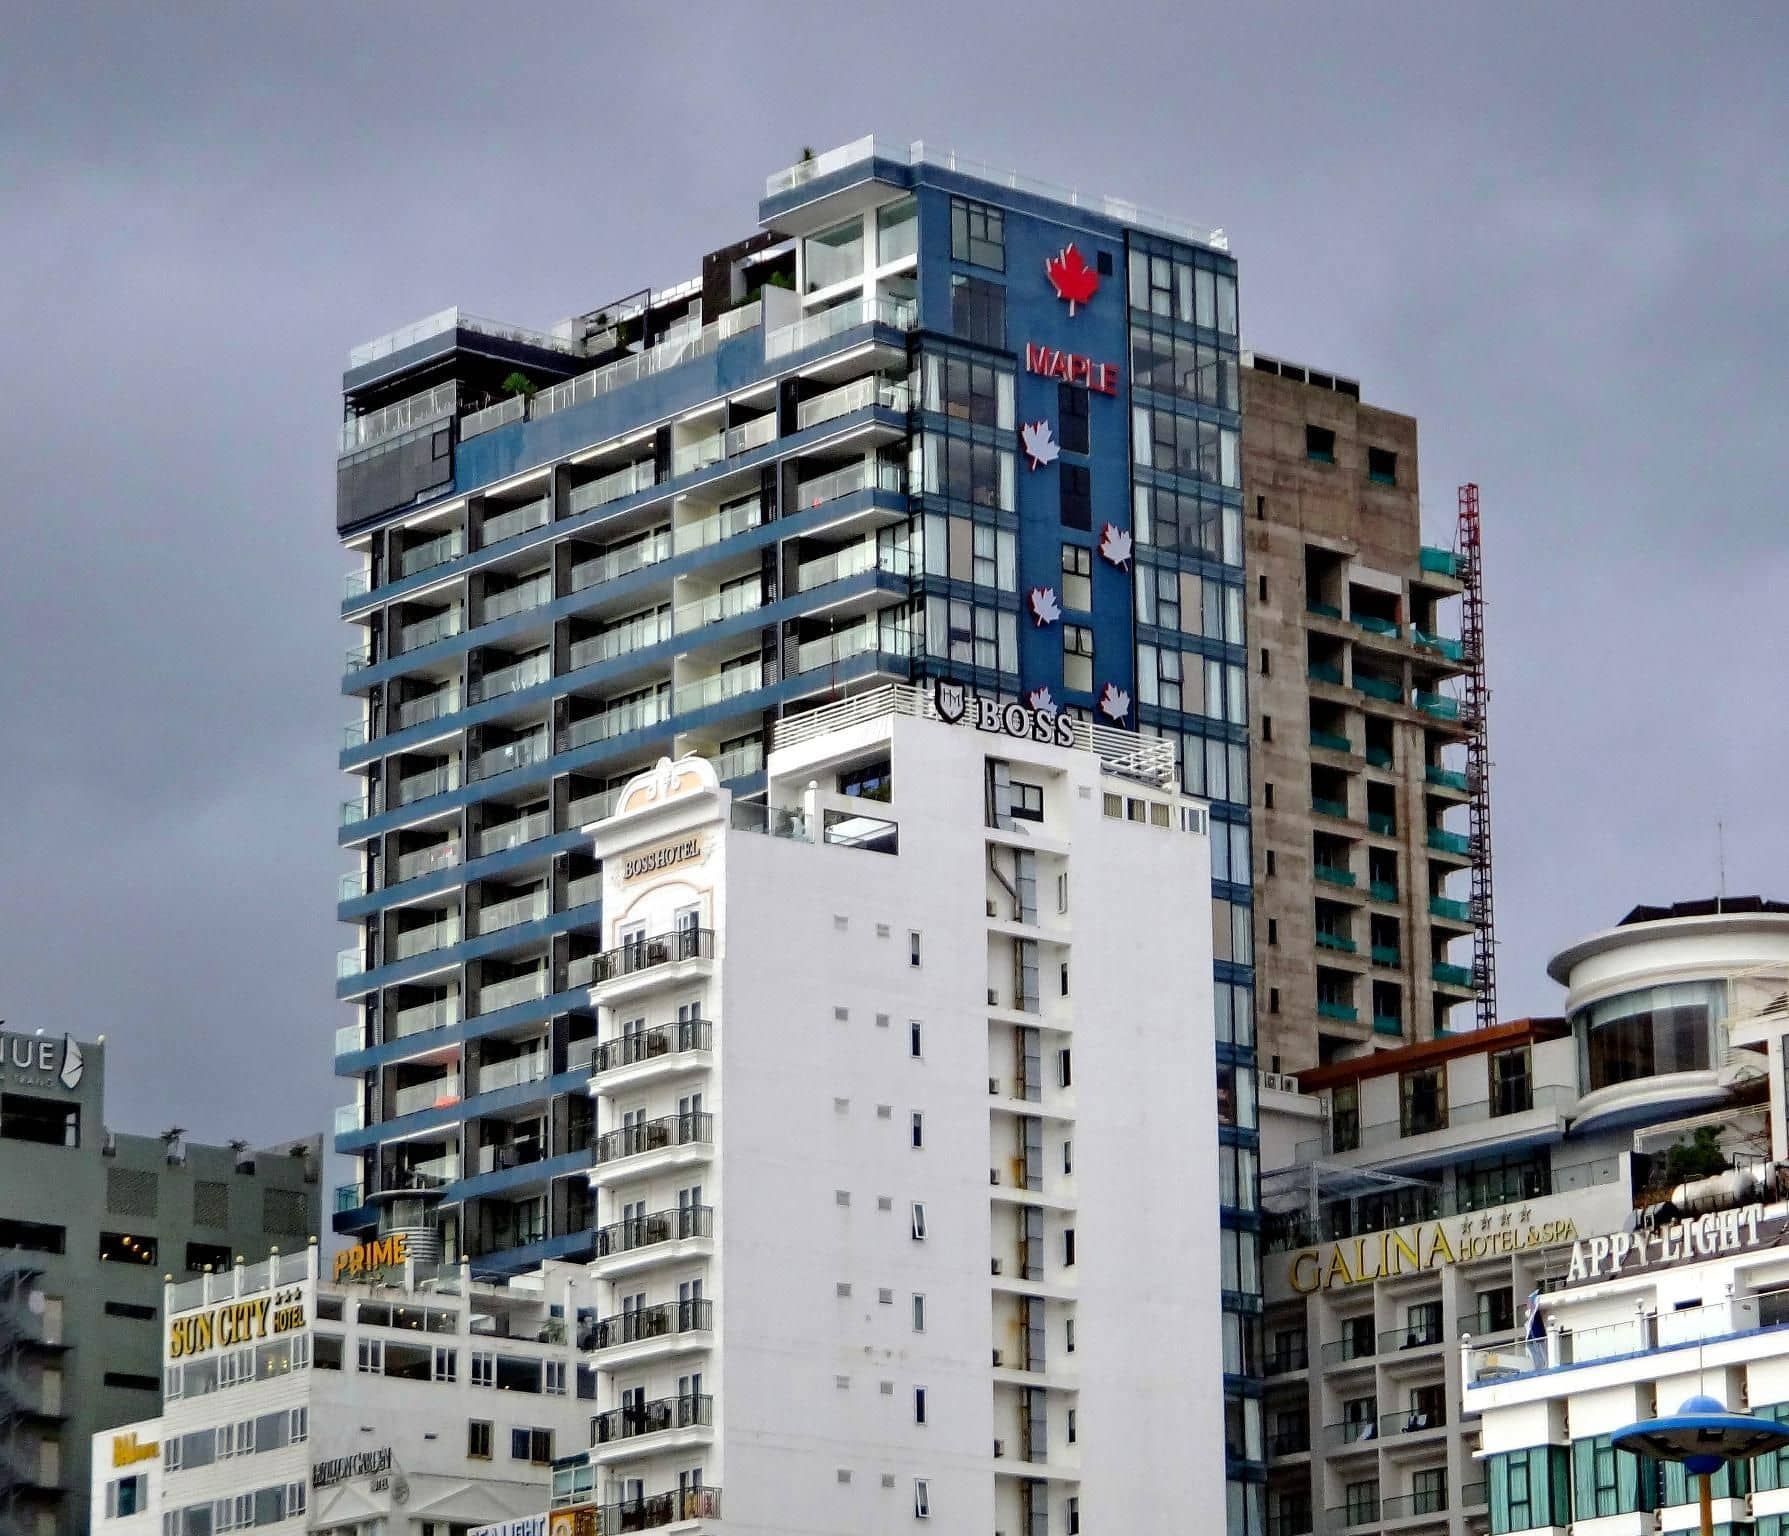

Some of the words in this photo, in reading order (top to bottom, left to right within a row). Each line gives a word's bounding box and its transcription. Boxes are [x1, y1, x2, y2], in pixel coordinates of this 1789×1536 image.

[1025, 342, 1119, 396] MAPLE
[976, 695, 1075, 748] BOSS
[0, 1038, 54, 1070] UE
[333, 1233, 408, 1282] PRIME
[1289, 1222, 1456, 1294] GALINA
[1658, 1203, 1764, 1263] LIGHT
[170, 1310, 215, 1359] SUN
[216, 1296, 273, 1347] CITY
[273, 1304, 306, 1333] HOTEL
